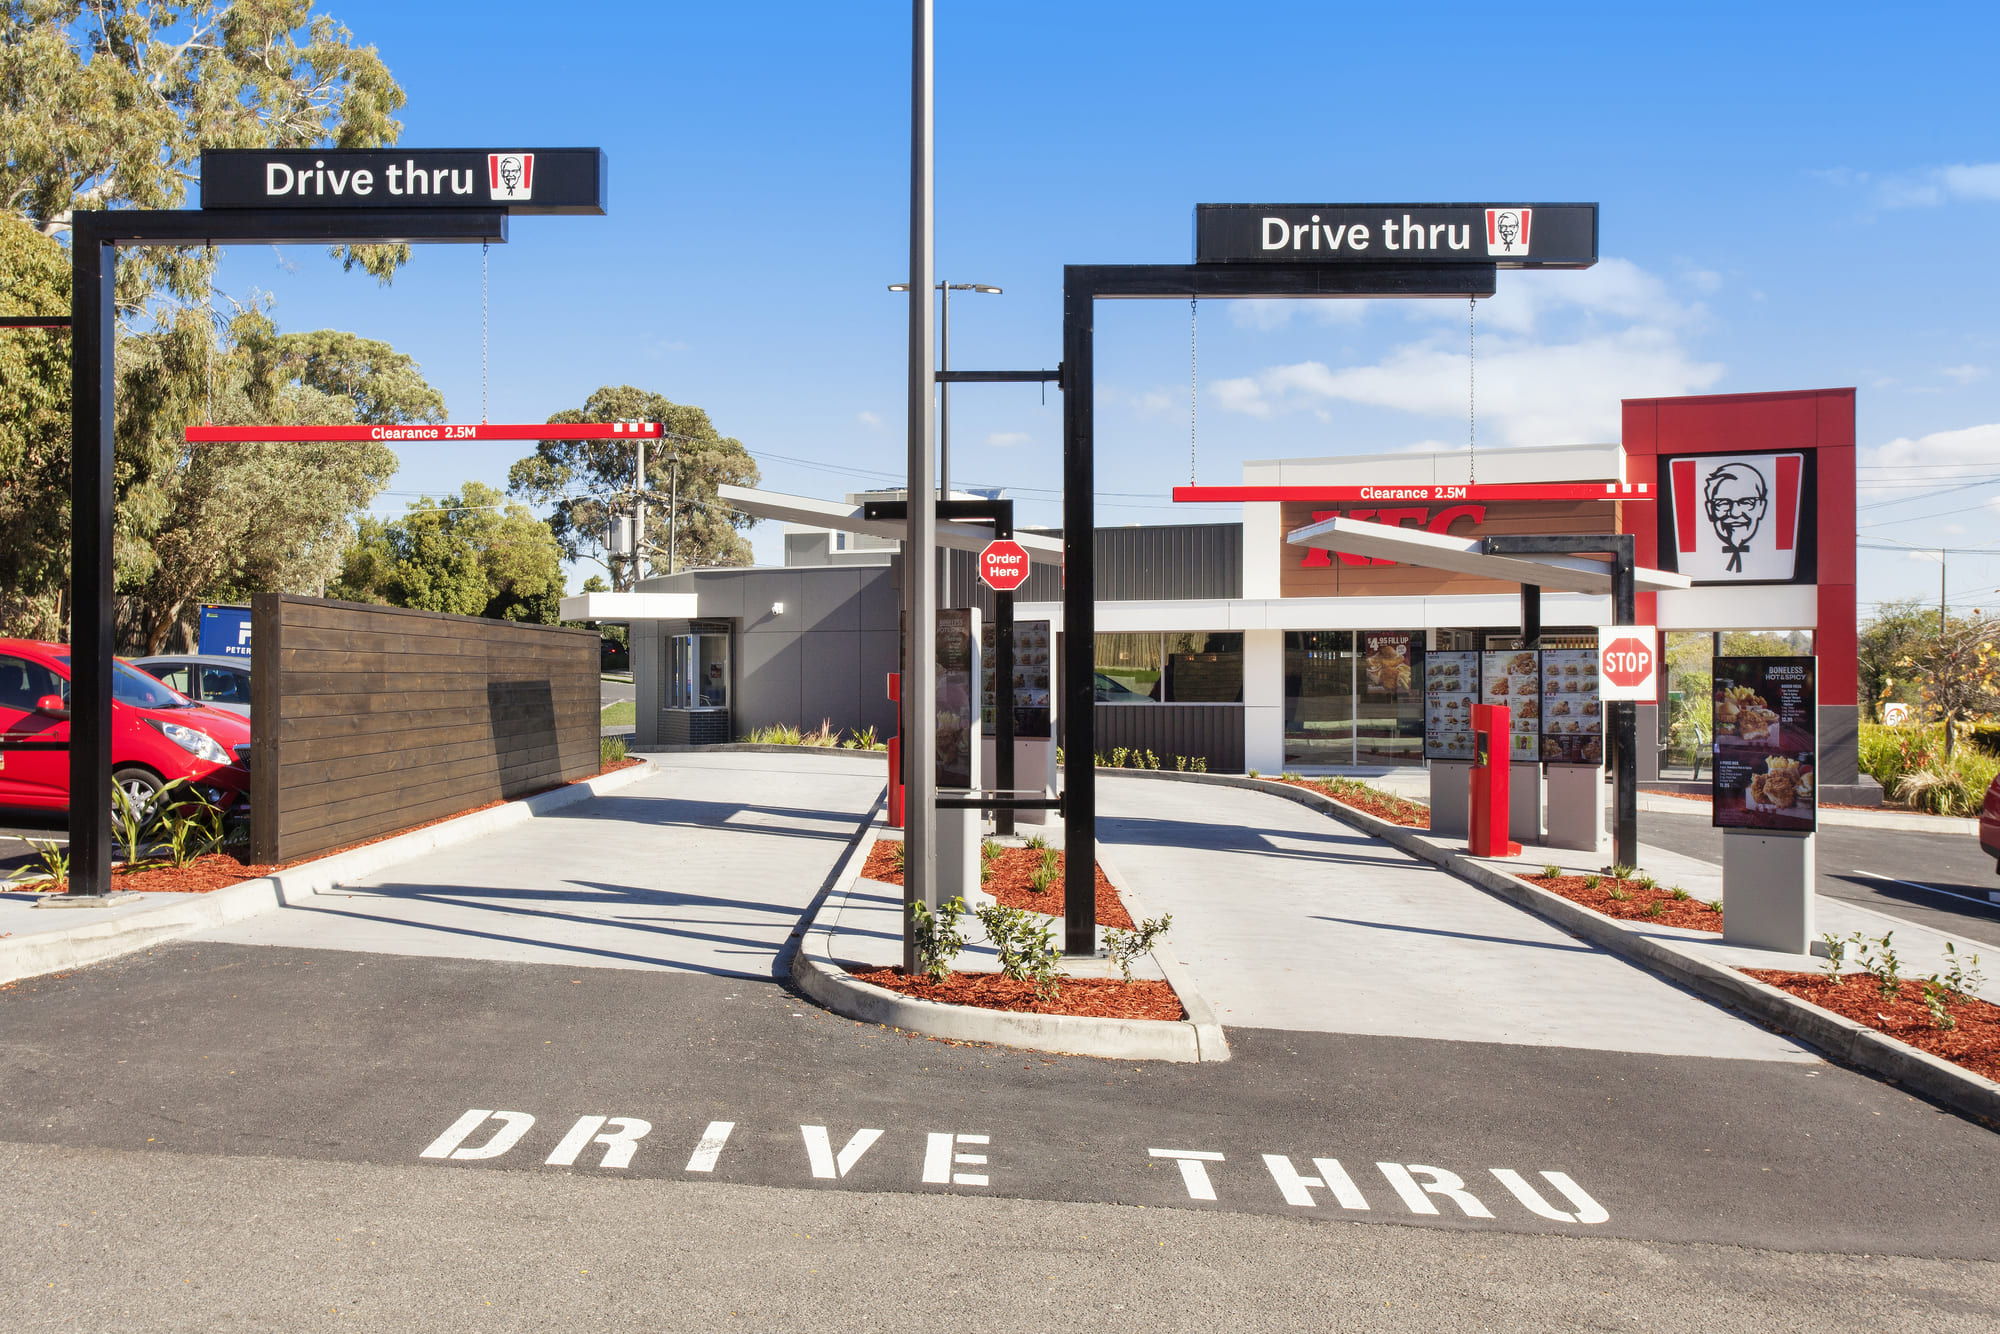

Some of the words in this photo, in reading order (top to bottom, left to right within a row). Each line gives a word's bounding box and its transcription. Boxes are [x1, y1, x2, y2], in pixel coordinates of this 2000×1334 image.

[266, 161, 374, 196] Drive
[385, 160, 474, 195] thru
[1261, 214, 1371, 251] Drive
[1381, 214, 1471, 251] thru
[371, 426, 439, 440] Clearance
[444, 426, 477, 440] 2.5M
[1360, 486, 1429, 500] Clearance
[1434, 486, 1467, 499] 2.5M
[986, 553, 1022, 565] Order
[989, 566, 1019, 577] Here
[1388, 636, 1400, 645] FILL
[1400, 636, 1409, 645] UP
[1605, 651, 1649, 673] STOP
[1768, 666, 1804, 674] BONELESS
[420, 1109, 990, 1186] DRIVE
[1148, 1148, 1611, 1225] THRU
